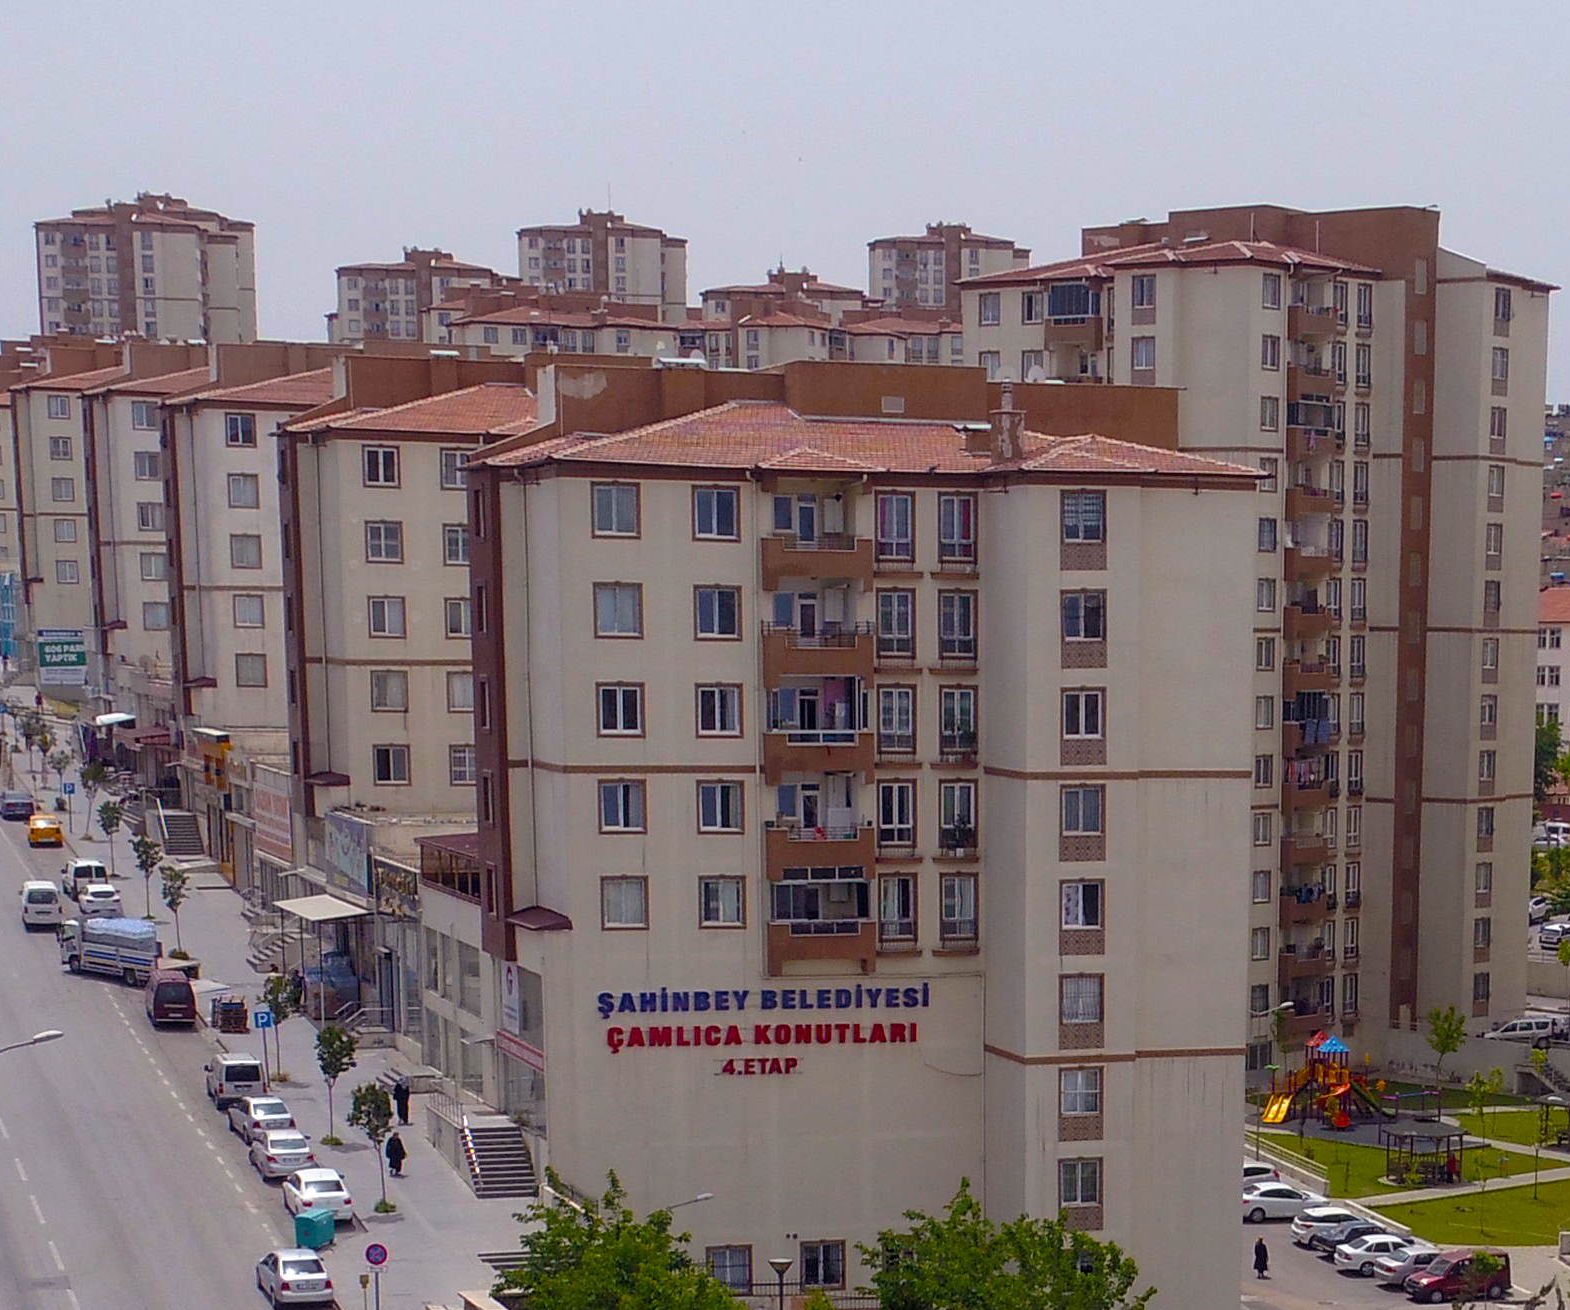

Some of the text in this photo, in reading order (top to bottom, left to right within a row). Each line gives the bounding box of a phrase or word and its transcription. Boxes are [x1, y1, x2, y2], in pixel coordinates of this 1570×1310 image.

[606, 1022, 918, 1054] ÇAMLICA KONUTLARI
[722, 1057, 799, 1076] 4.ETAP
